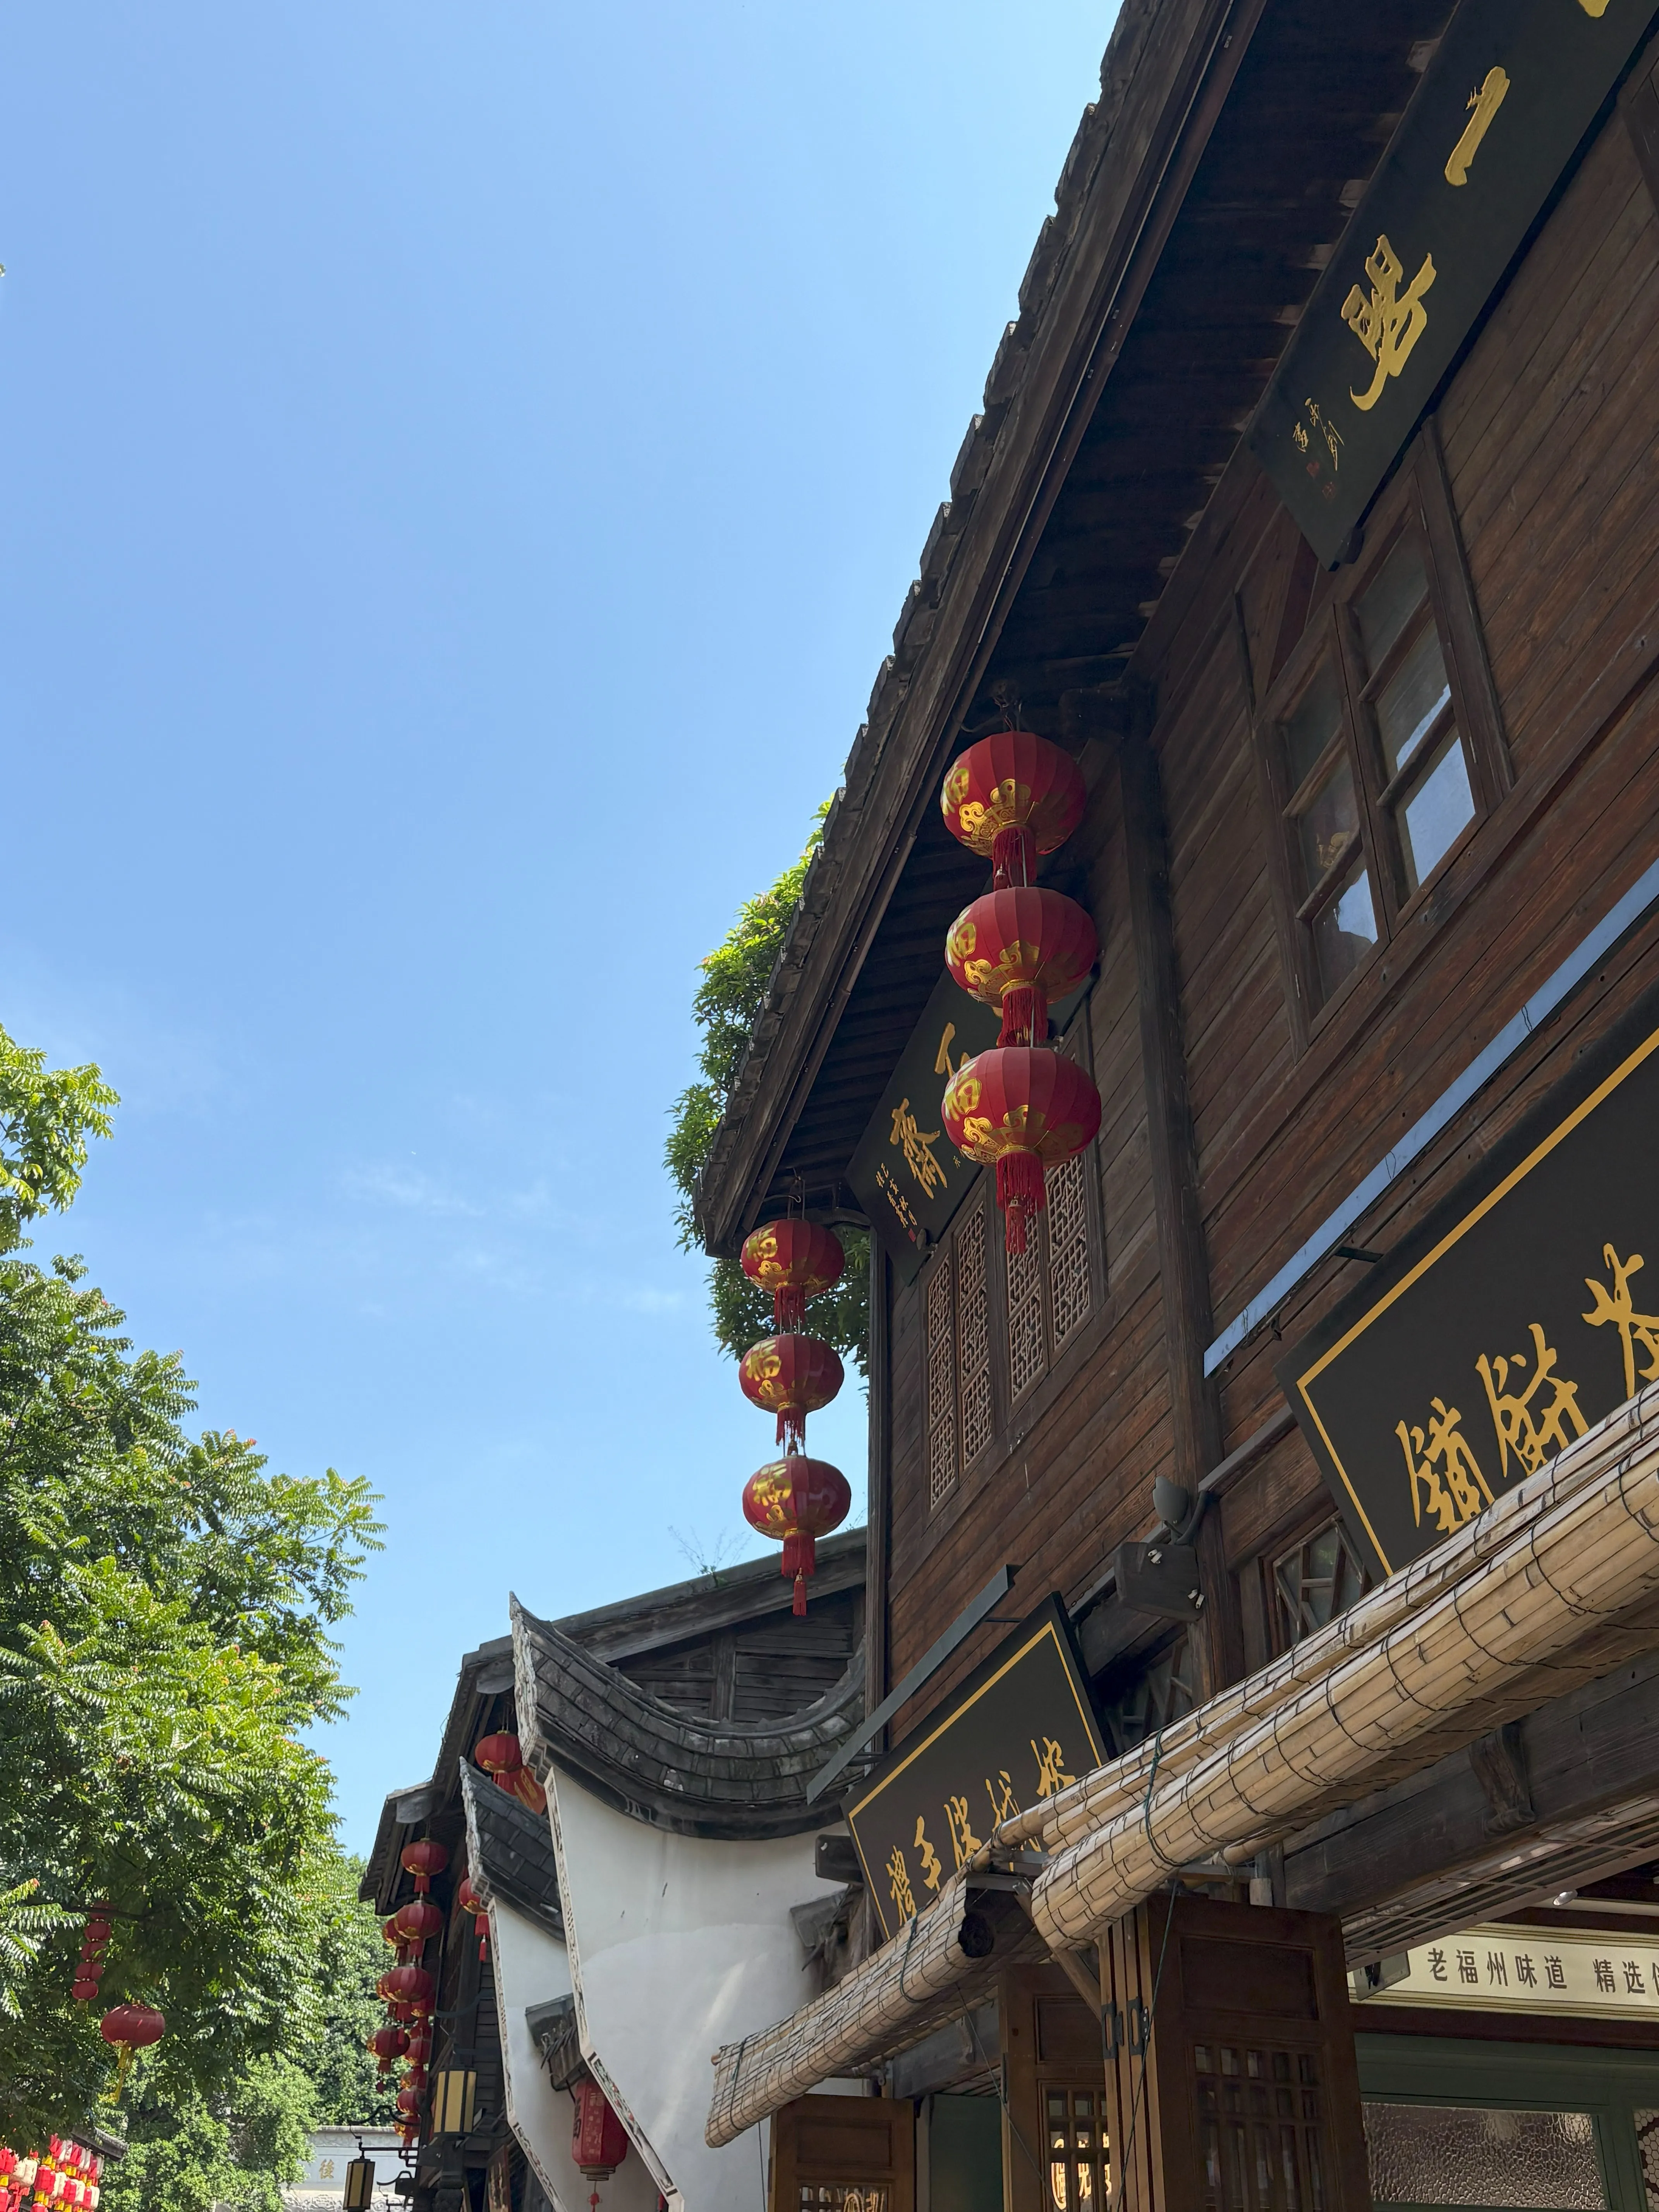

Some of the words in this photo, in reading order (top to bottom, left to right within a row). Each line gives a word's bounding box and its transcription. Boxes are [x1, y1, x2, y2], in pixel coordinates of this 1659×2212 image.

[745, 1227, 778, 1262] 福
[745, 1338, 783, 1382] 福
[752, 1463, 792, 1508] 福
[1427, 1948, 1568, 1989] 老福州味道
